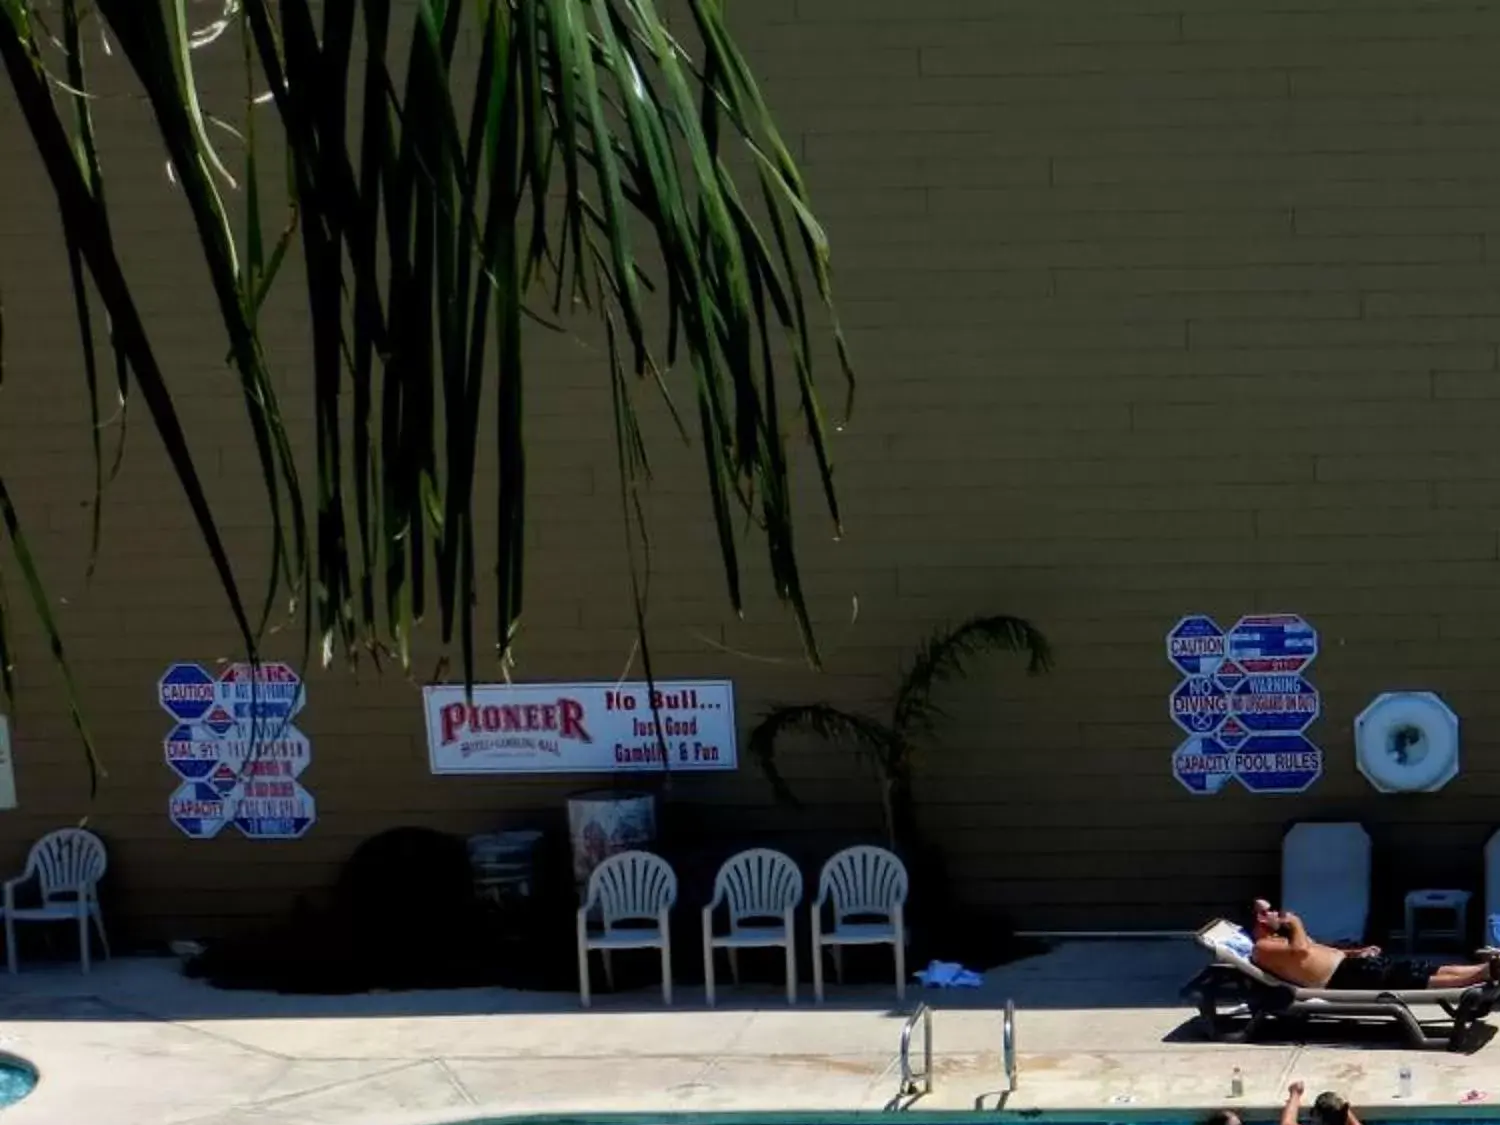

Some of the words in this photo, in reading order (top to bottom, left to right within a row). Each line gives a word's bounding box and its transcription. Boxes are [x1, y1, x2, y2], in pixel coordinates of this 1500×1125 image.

[1172, 639, 1225, 656] CAUTION
[162, 684, 214, 701] CAUTION
[1190, 679, 1211, 696] NO
[1250, 678, 1301, 694] WARNING
[605, 691, 637, 710] No
[1174, 696, 1227, 714] DIVING
[441, 698, 592, 746] PIONEER
[665, 715, 698, 736] Good
[168, 743, 194, 760] DIAL
[694, 740, 720, 761] Fun
[1176, 755, 1231, 772] CAPACITY
[1235, 754, 1271, 770] POOL
[1276, 753, 1319, 770] RULES
[172, 801, 223, 818] CAPACITY
